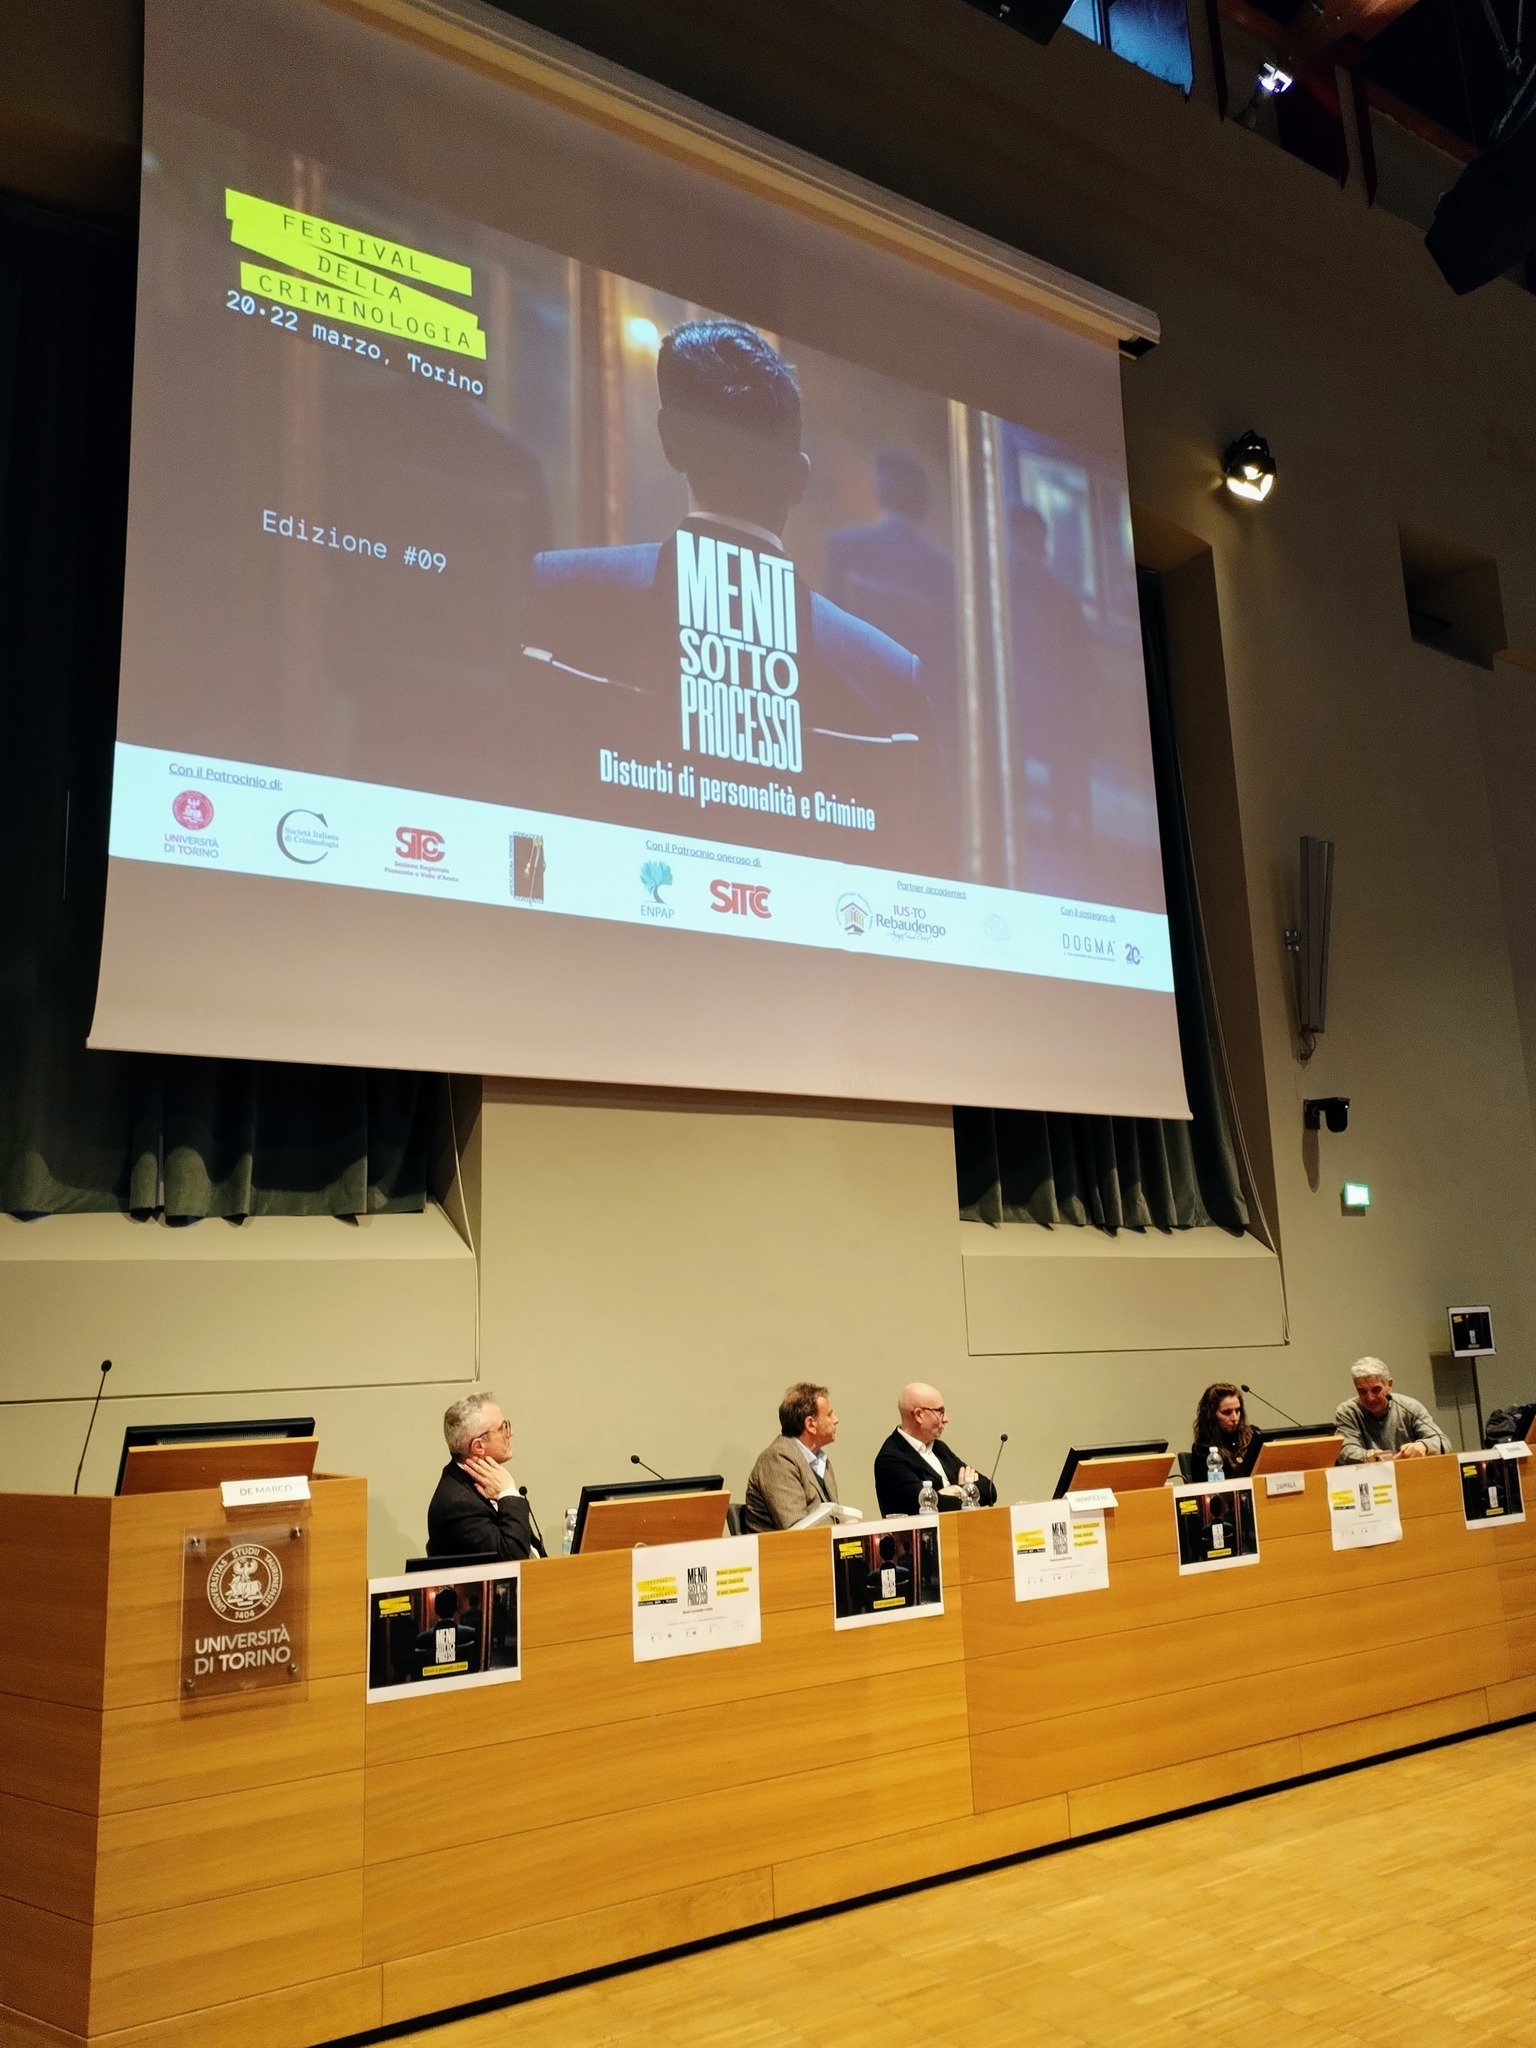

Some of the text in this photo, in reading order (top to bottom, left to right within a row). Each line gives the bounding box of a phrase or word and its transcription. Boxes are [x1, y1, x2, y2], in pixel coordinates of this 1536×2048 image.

[282, 213, 422, 274] FESTIVAL
[317, 255, 402, 304] DELLA
[258, 274, 470, 349] CRIMINOLOGIA
[312, 323, 390, 366] marzo,
[407, 353, 484, 396] Torino
[262, 509, 447, 574] Edizione #09
[676, 529, 798, 654] MENTI
[679, 628, 799, 697] SOTTO
[680, 673, 802, 773] PROCESSO
[169, 762, 283, 791] Con il Patrocinio di:
[600, 749, 876, 831] Disturbi di personalità e Crimine
[164, 833, 219, 848] UNIVERSITÀ
[164, 843, 219, 859] DI TORINO
[645, 839, 664, 851] Con
[672, 844, 715, 860] Patrocinio
[717, 852, 751, 864] oneroso
[897, 880, 925, 893] Partner
[640, 905, 675, 919] ENPAP
[876, 914, 946, 938] Rebaudengo
[1061, 906, 1074, 916] Con
[1062, 932, 1115, 956] DOGMA
[239, 1483, 293, 1497] DE MARCO
[231, 1547, 260, 1559] STUDII
[210, 1559, 228, 1613] UNIVERSITAS
[262, 1553, 279, 1608] TAURINENSIS
[235, 1609, 255, 1619] 1404
[195, 1623, 290, 1655] UNIVERSITÀ
[194, 1645, 291, 1676] DI TORINO
